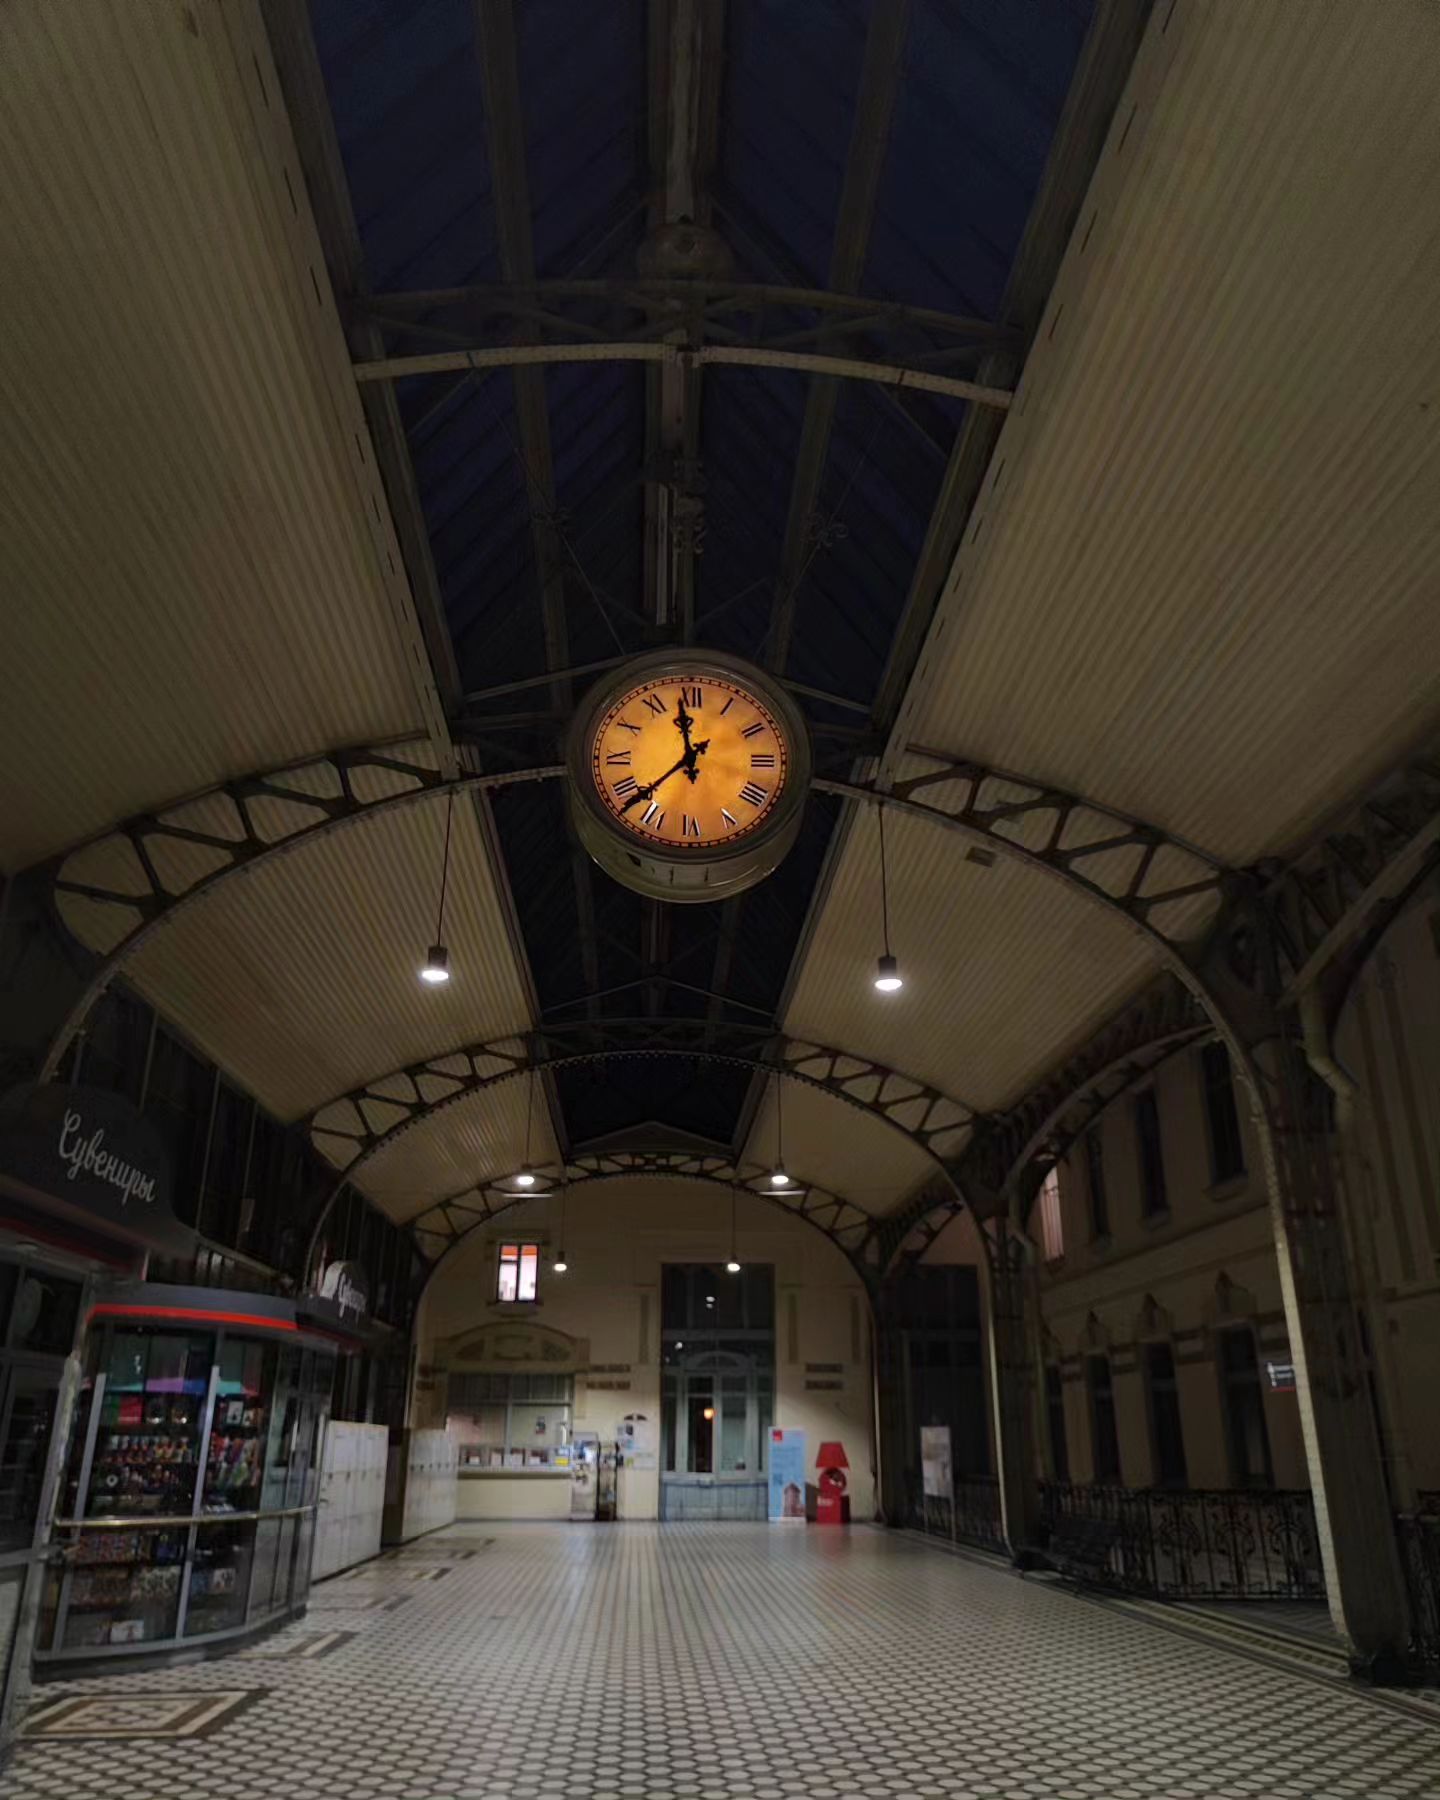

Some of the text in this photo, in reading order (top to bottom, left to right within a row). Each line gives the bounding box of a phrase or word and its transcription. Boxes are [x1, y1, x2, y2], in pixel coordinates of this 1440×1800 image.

[642, 693, 667, 719] XI
[681, 686, 702, 709] XII
[720, 697, 734, 716] I
[616, 716, 642, 737] X
[741, 722, 765, 739] II
[606, 749, 631, 765] IX
[751, 754, 775, 768] III
[738, 780, 769, 807] IIII
[640, 800, 666, 831] VII
[682, 814, 701, 836] VI
[721, 807, 737, 829] V
[59, 1108, 156, 1206] Сувениры
